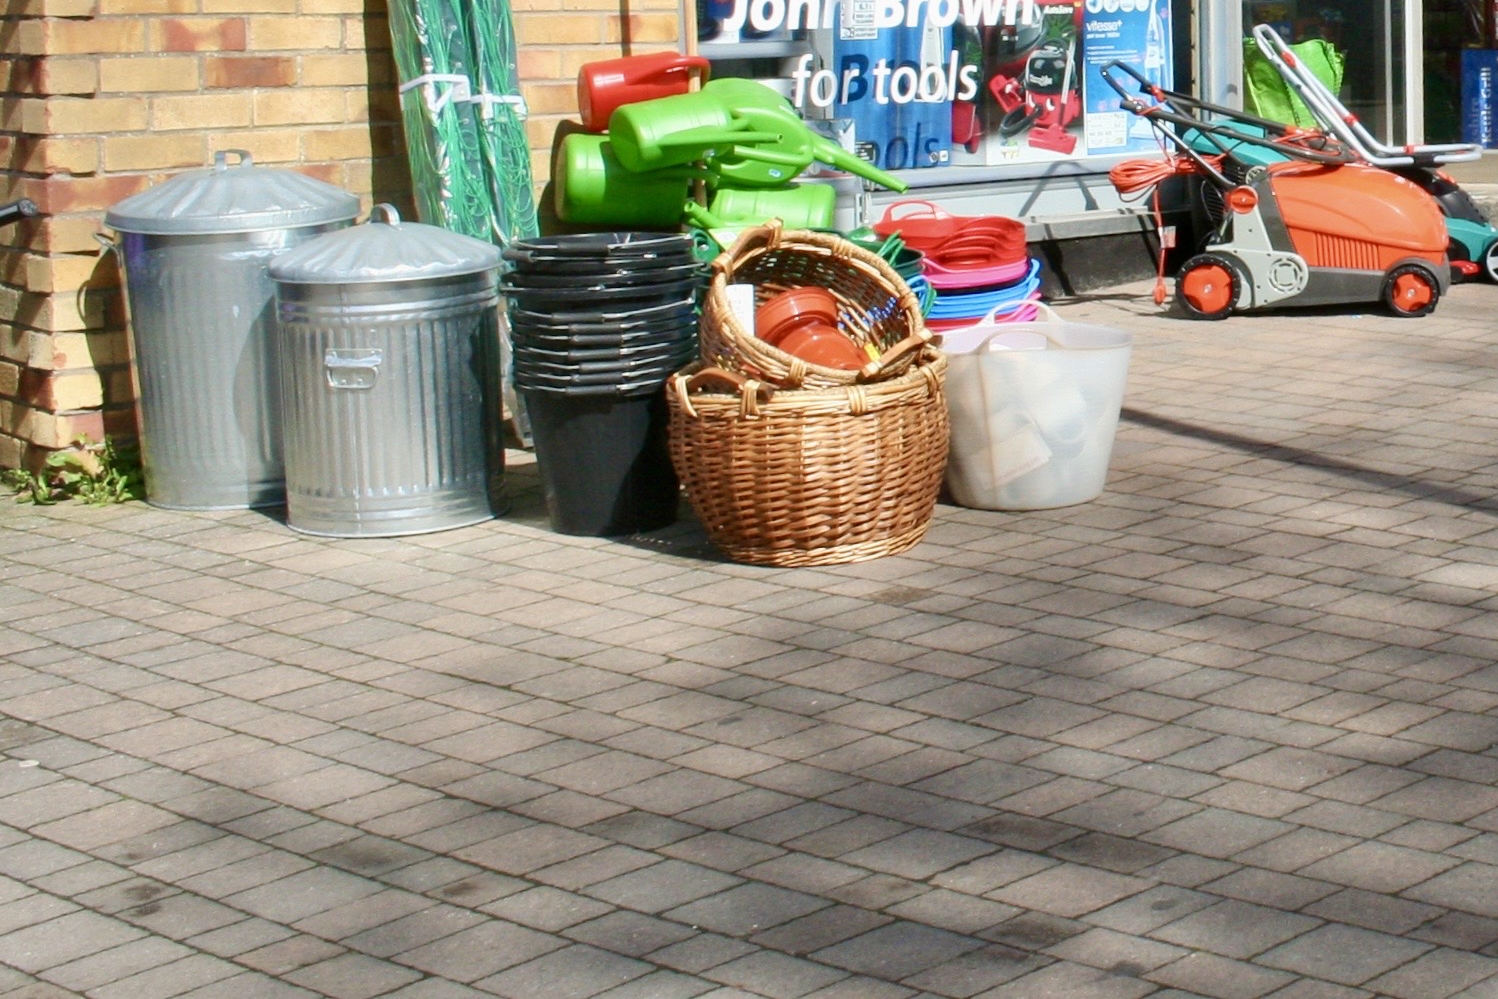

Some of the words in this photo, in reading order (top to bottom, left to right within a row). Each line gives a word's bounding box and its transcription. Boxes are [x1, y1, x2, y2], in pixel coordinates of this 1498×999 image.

[792, 53, 860, 107] for
[873, 49, 978, 105] tools
[1480, 67, 1491, 99] Grill
